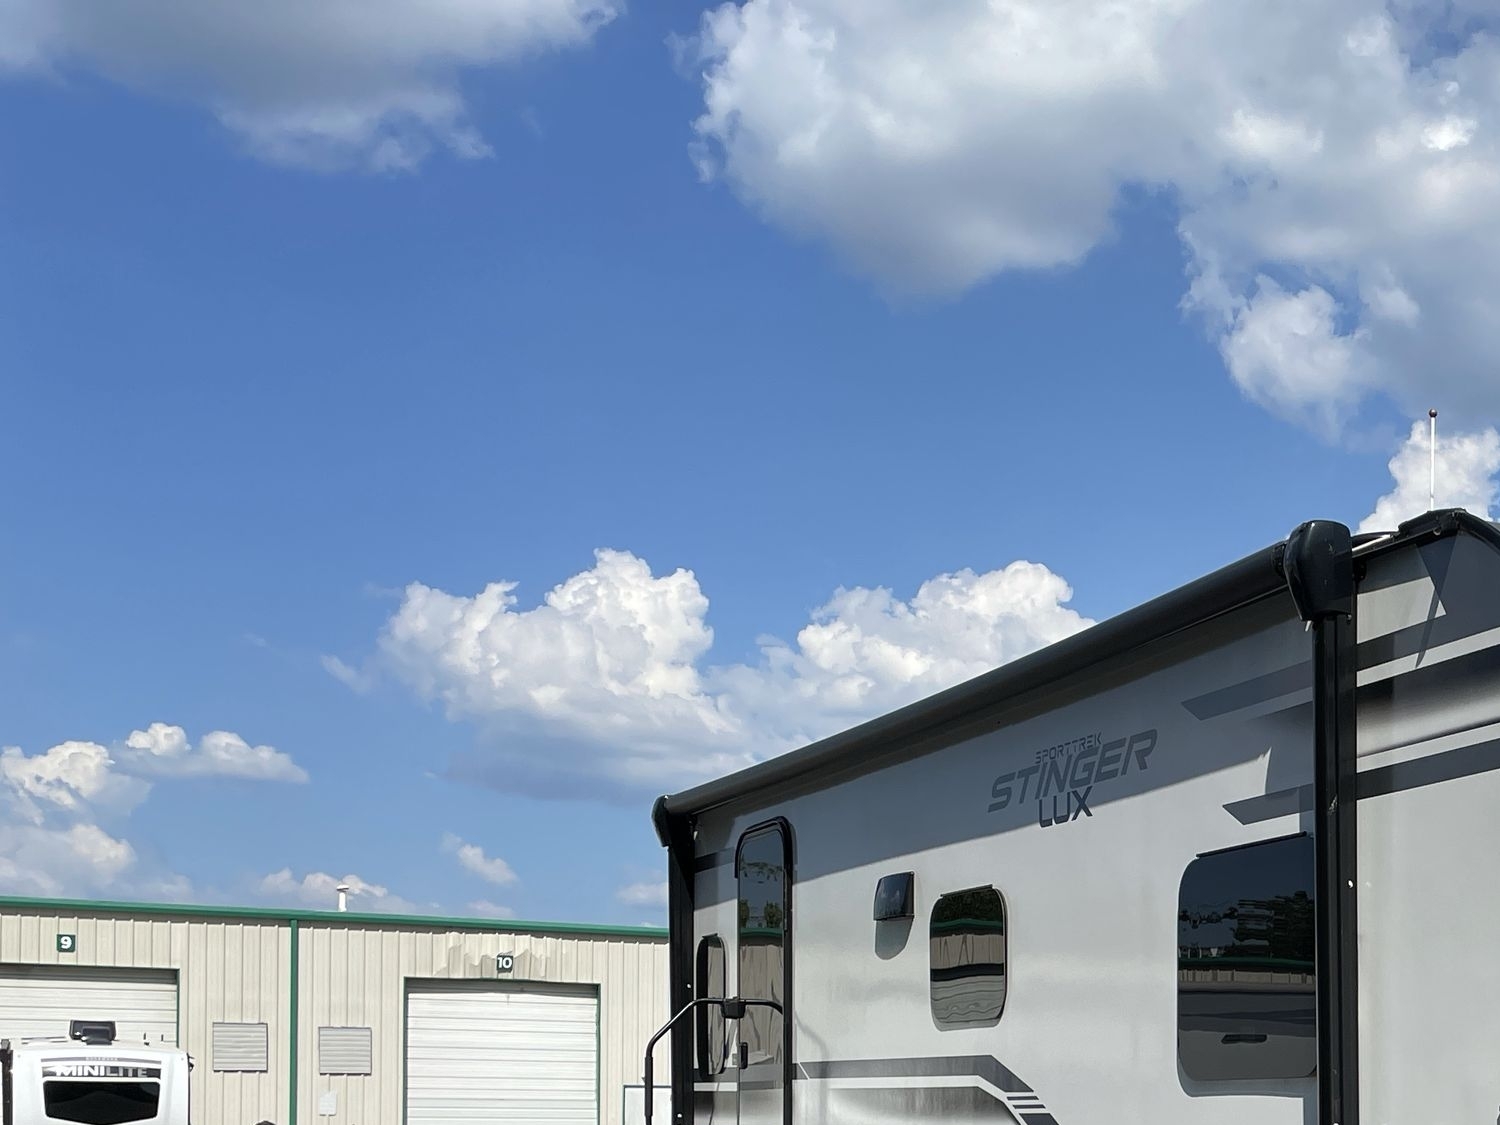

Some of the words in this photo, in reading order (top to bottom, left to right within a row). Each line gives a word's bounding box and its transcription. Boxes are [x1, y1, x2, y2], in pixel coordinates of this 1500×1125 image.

[1035, 732, 1102, 764] SPORTTREK
[988, 729, 1157, 813] STINGER
[1039, 785, 1093, 828] LUX
[60, 935, 72, 950] 9
[497, 956, 513, 969] 10
